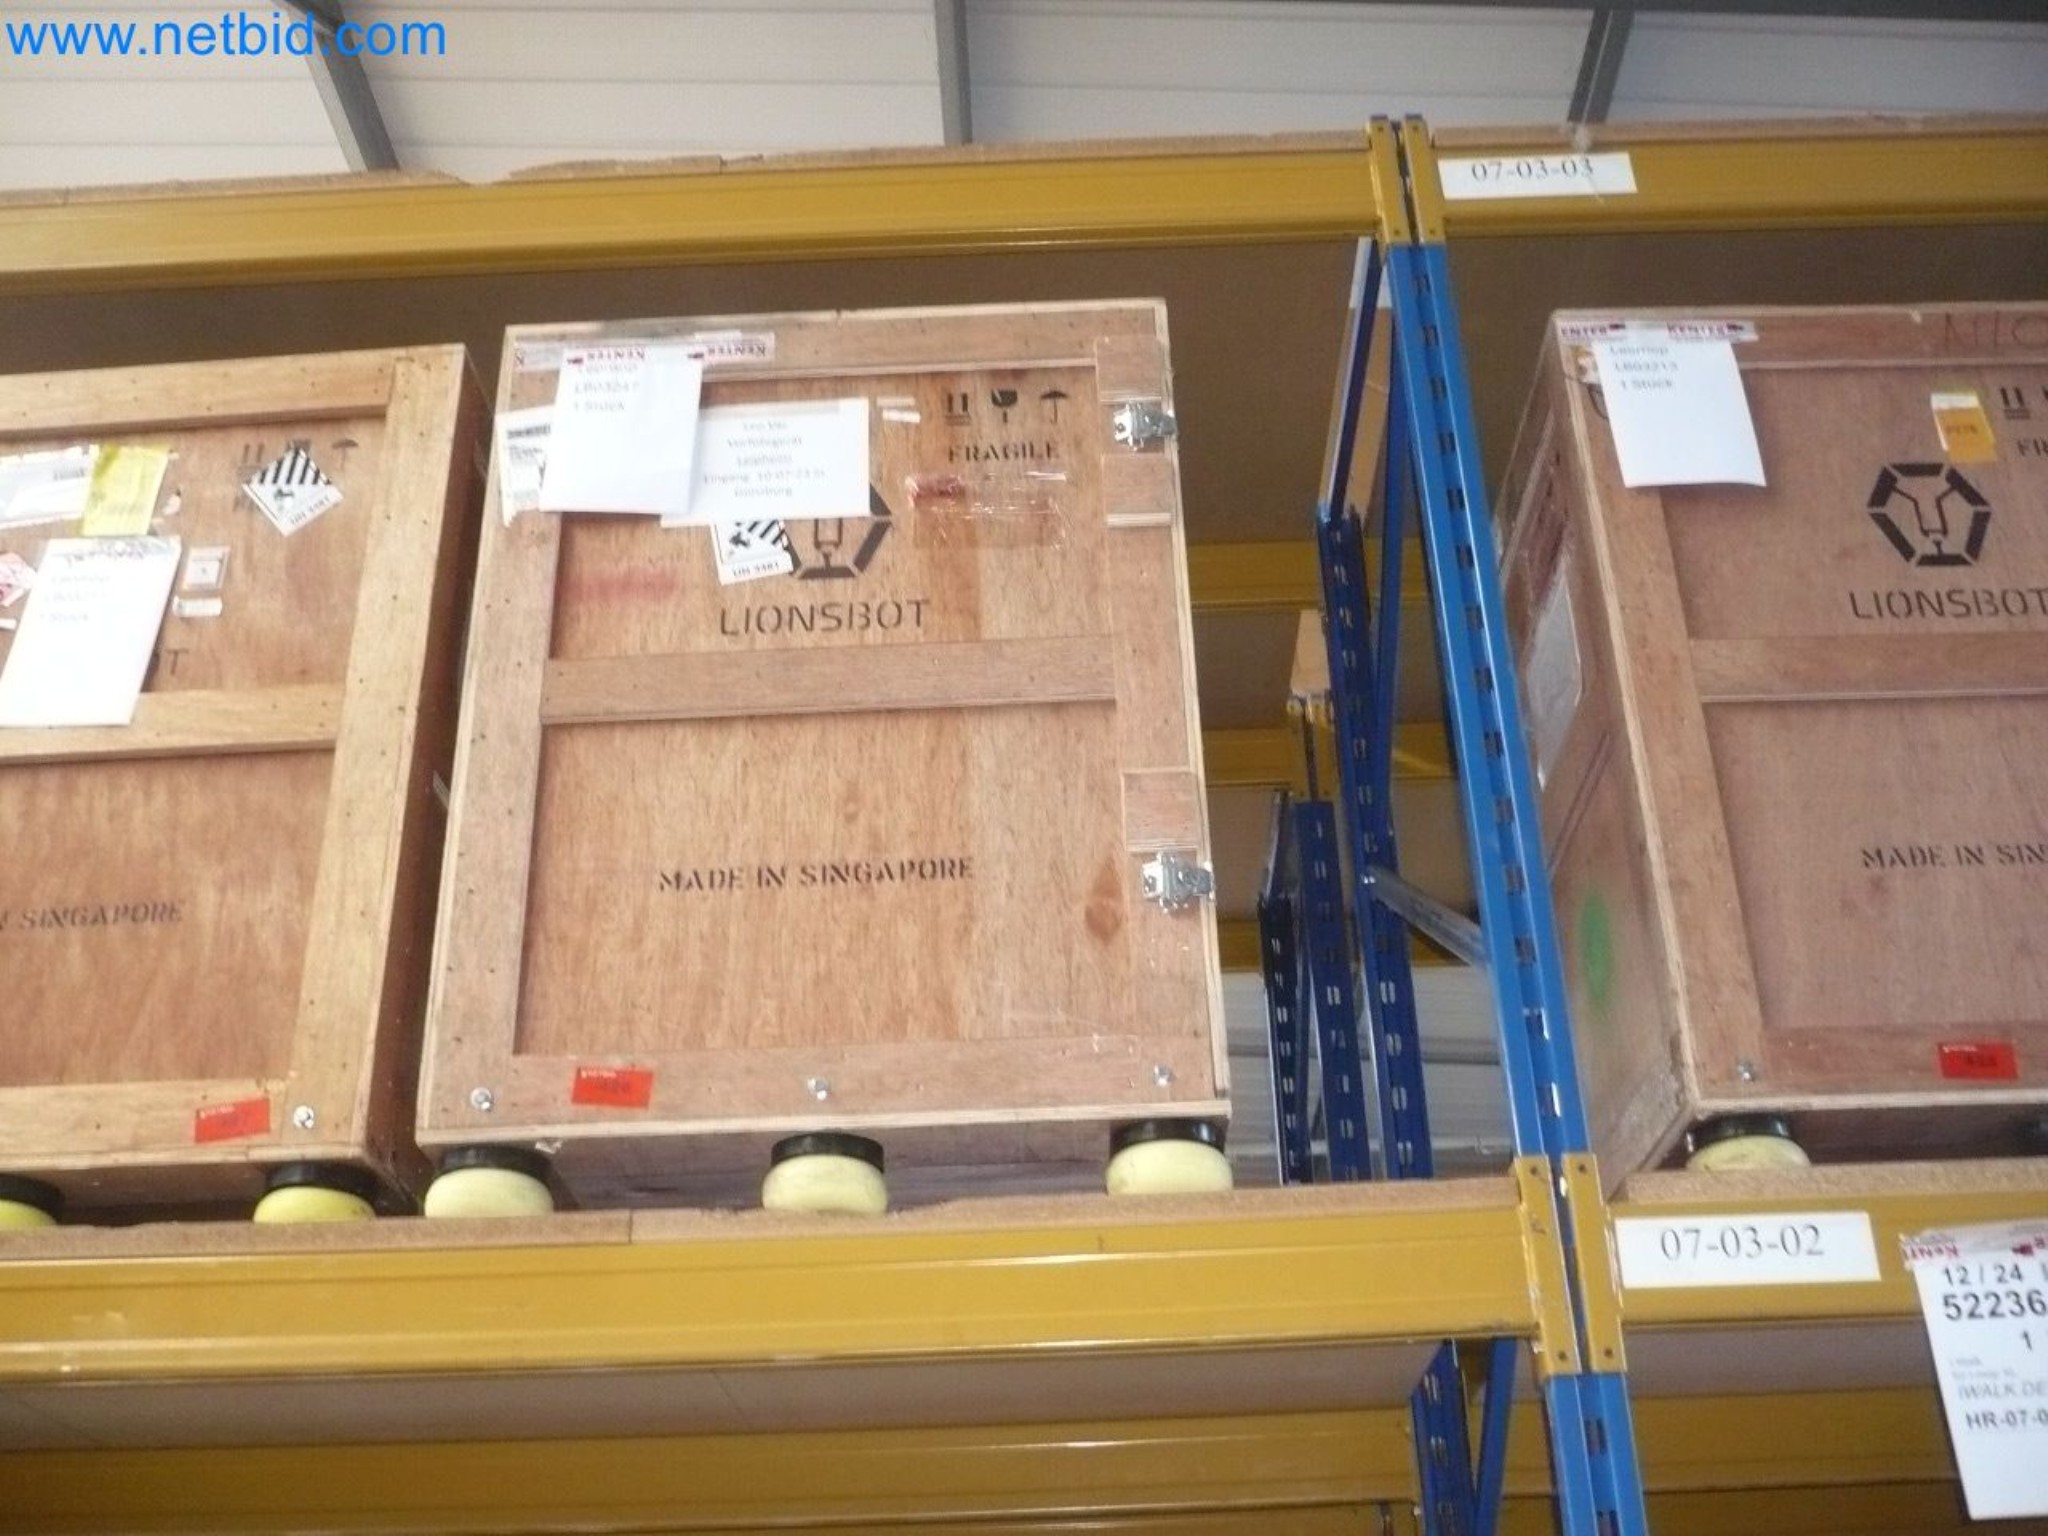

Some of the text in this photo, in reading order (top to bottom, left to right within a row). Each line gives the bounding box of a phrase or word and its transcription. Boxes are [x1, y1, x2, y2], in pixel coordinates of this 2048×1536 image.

[1471, 156, 1594, 182] 07-03-03
[948, 442, 1060, 464] FRAGILE
[721, 600, 930, 636] LIONSBOT
[1850, 588, 2048, 619] LIONSBOT
[1862, 845, 1943, 869] MADE
[1956, 843, 1986, 865] IN
[660, 857, 974, 892] MADE IN SINGAPORE
[19, 901, 183, 930] SINGAPORE
[1660, 1225, 1824, 1261] 07-03-02
[1944, 1265, 1971, 1286] 12
[1994, 1263, 2022, 1284] 24
[1943, 1289, 2047, 1321] 52236
[2022, 1330, 2032, 1351] 1
